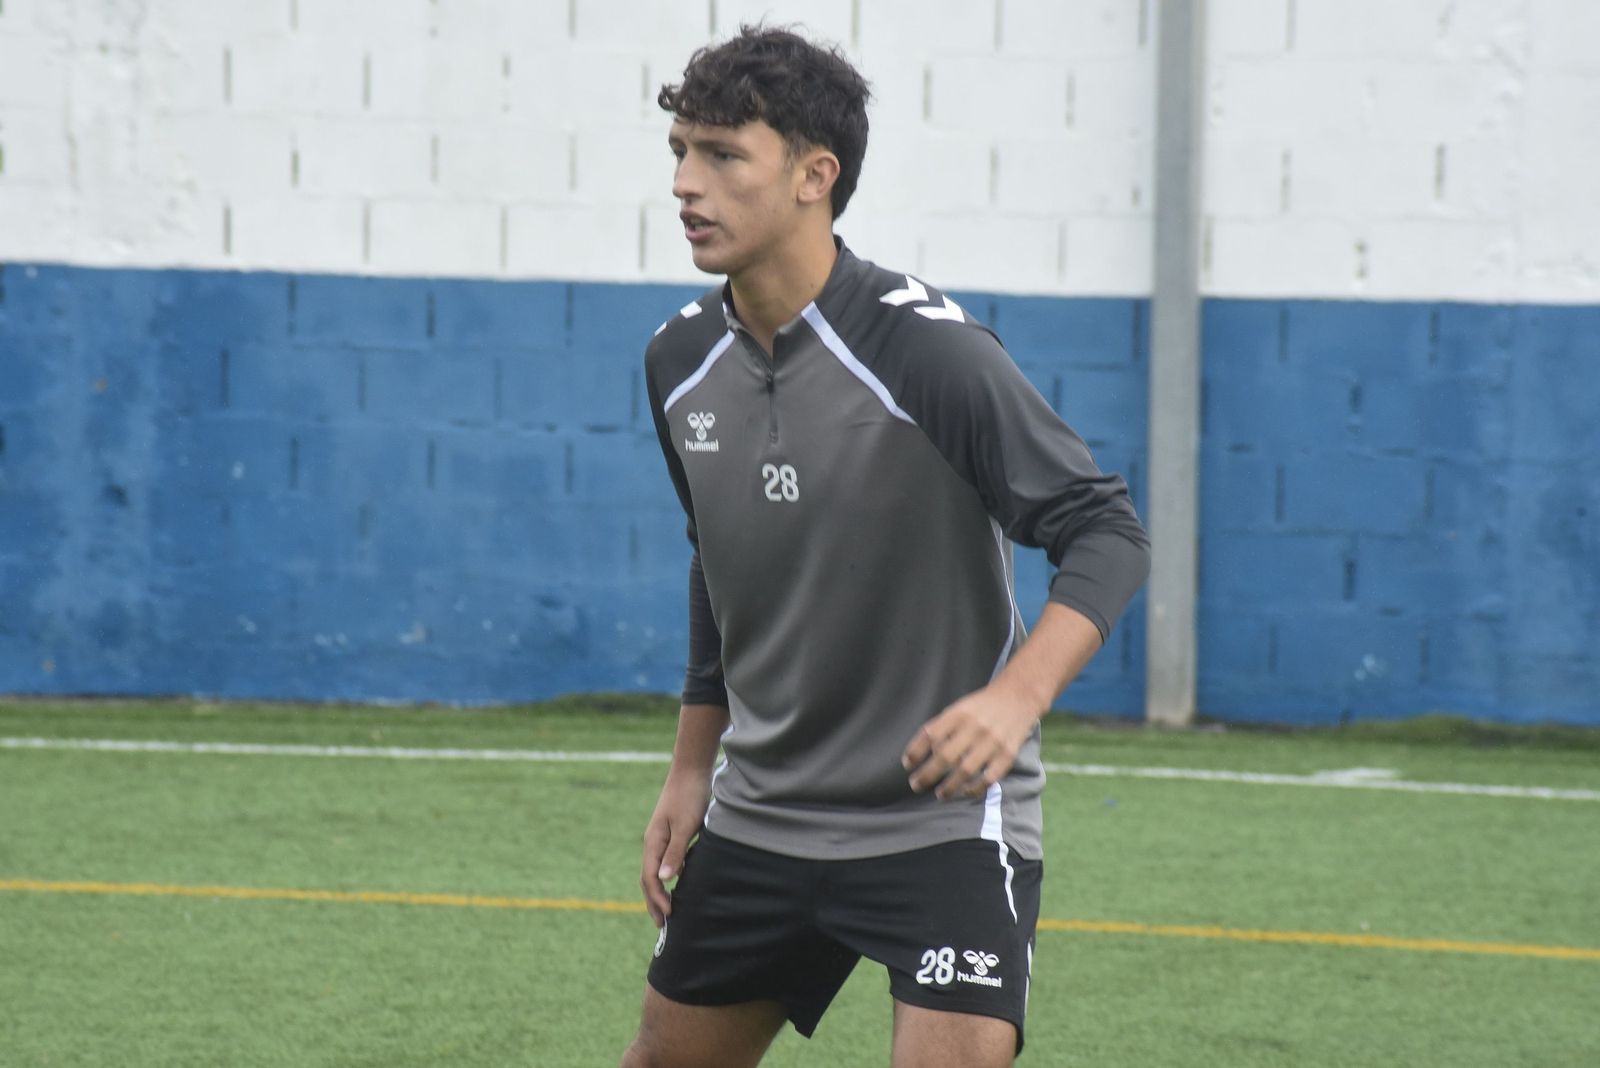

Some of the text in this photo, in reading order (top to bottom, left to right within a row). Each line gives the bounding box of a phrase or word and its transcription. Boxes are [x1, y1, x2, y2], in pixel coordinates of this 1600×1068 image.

[685, 438, 719, 452] hummel
[762, 463, 800, 502] 28
[916, 947, 956, 985] 28
[957, 970, 1002, 988] hummel
